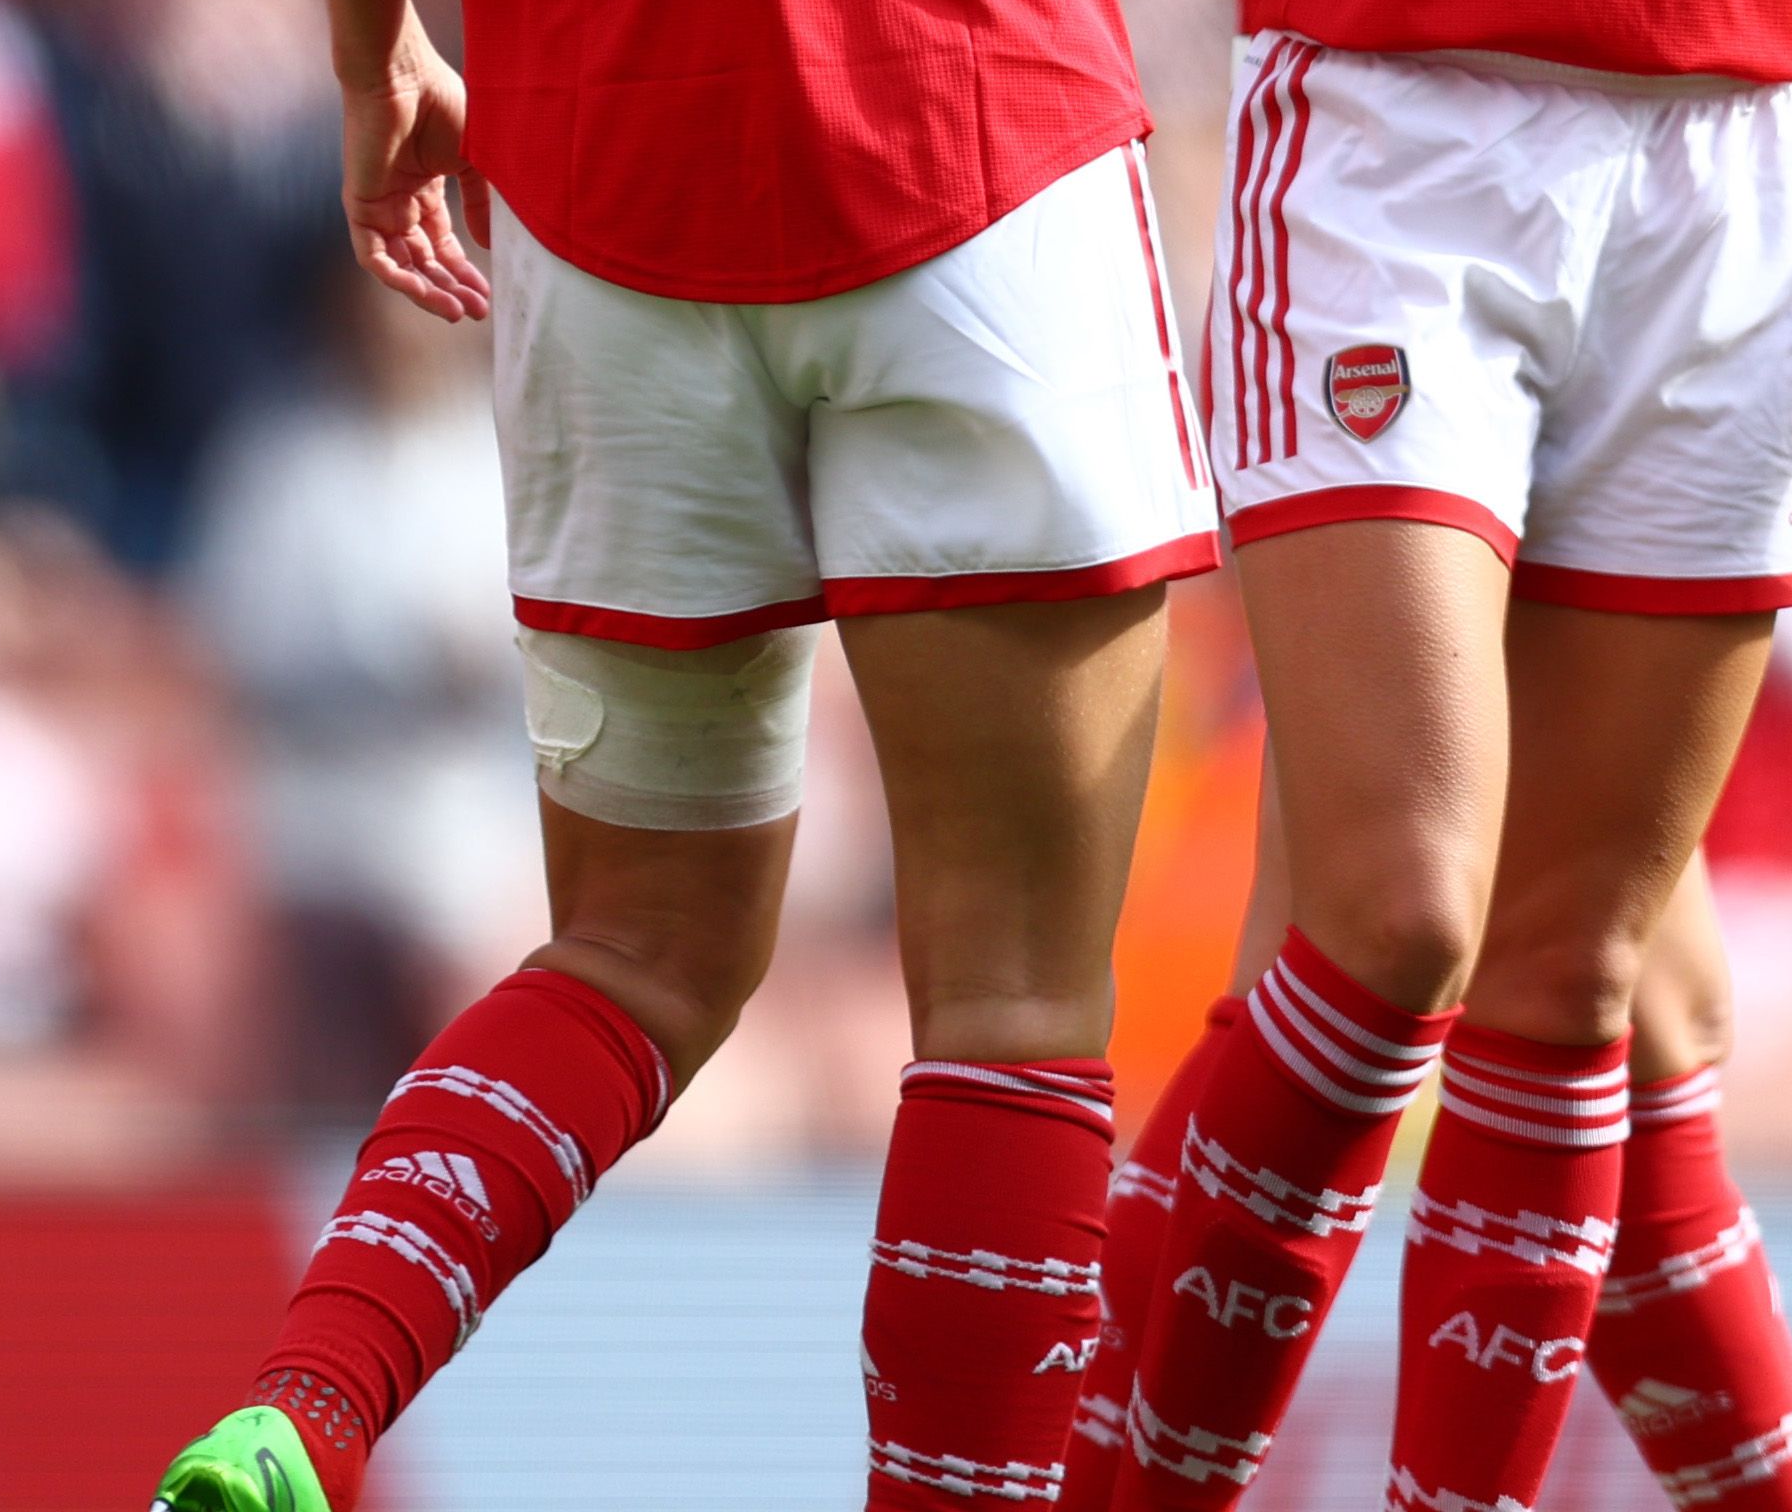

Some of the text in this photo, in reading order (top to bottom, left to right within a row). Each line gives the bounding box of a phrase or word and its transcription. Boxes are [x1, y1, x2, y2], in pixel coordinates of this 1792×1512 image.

[1335, 359, 1398, 380] Arsenal
[361, 1169, 500, 1242] adidas
[1172, 1266, 1313, 1339] AFC
[1033, 1337, 1099, 1374] AF
[1428, 1310, 1585, 1383] AFC
